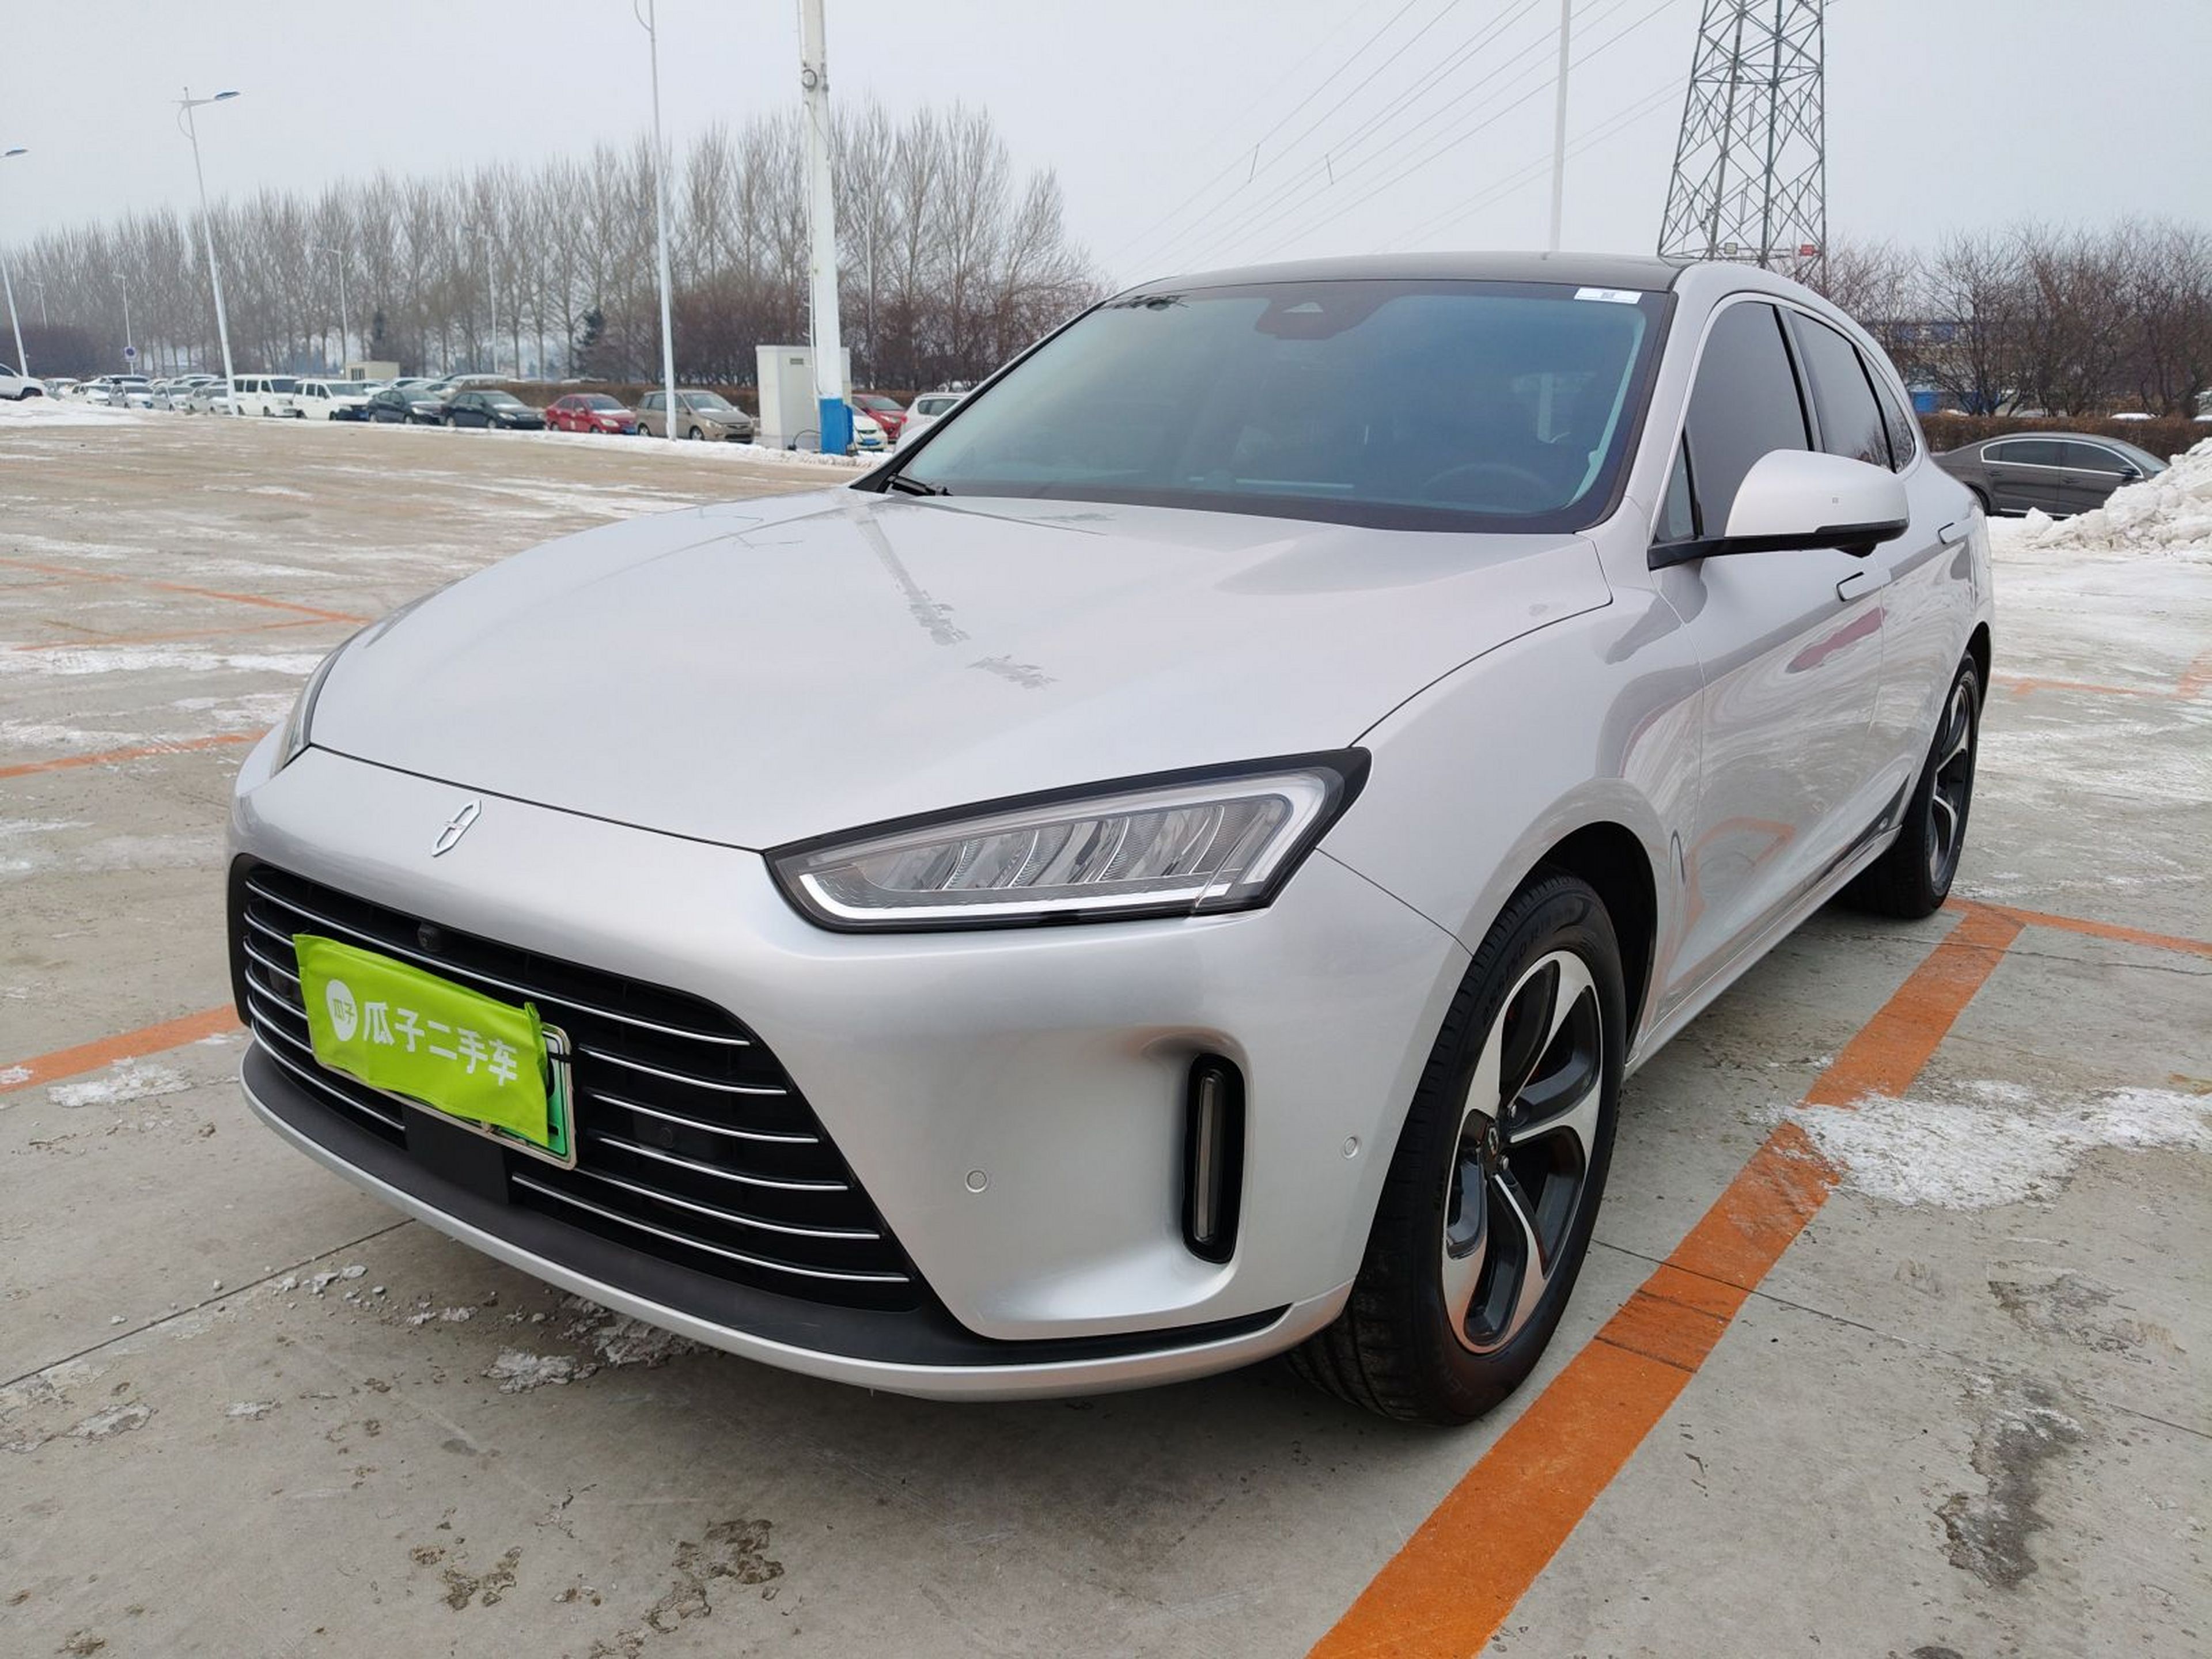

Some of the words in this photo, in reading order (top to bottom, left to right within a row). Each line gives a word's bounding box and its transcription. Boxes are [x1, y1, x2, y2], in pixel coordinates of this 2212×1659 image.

[333, 998, 355, 1025] 瓜子
[363, 1002, 517, 1086] 瓜子二手车
